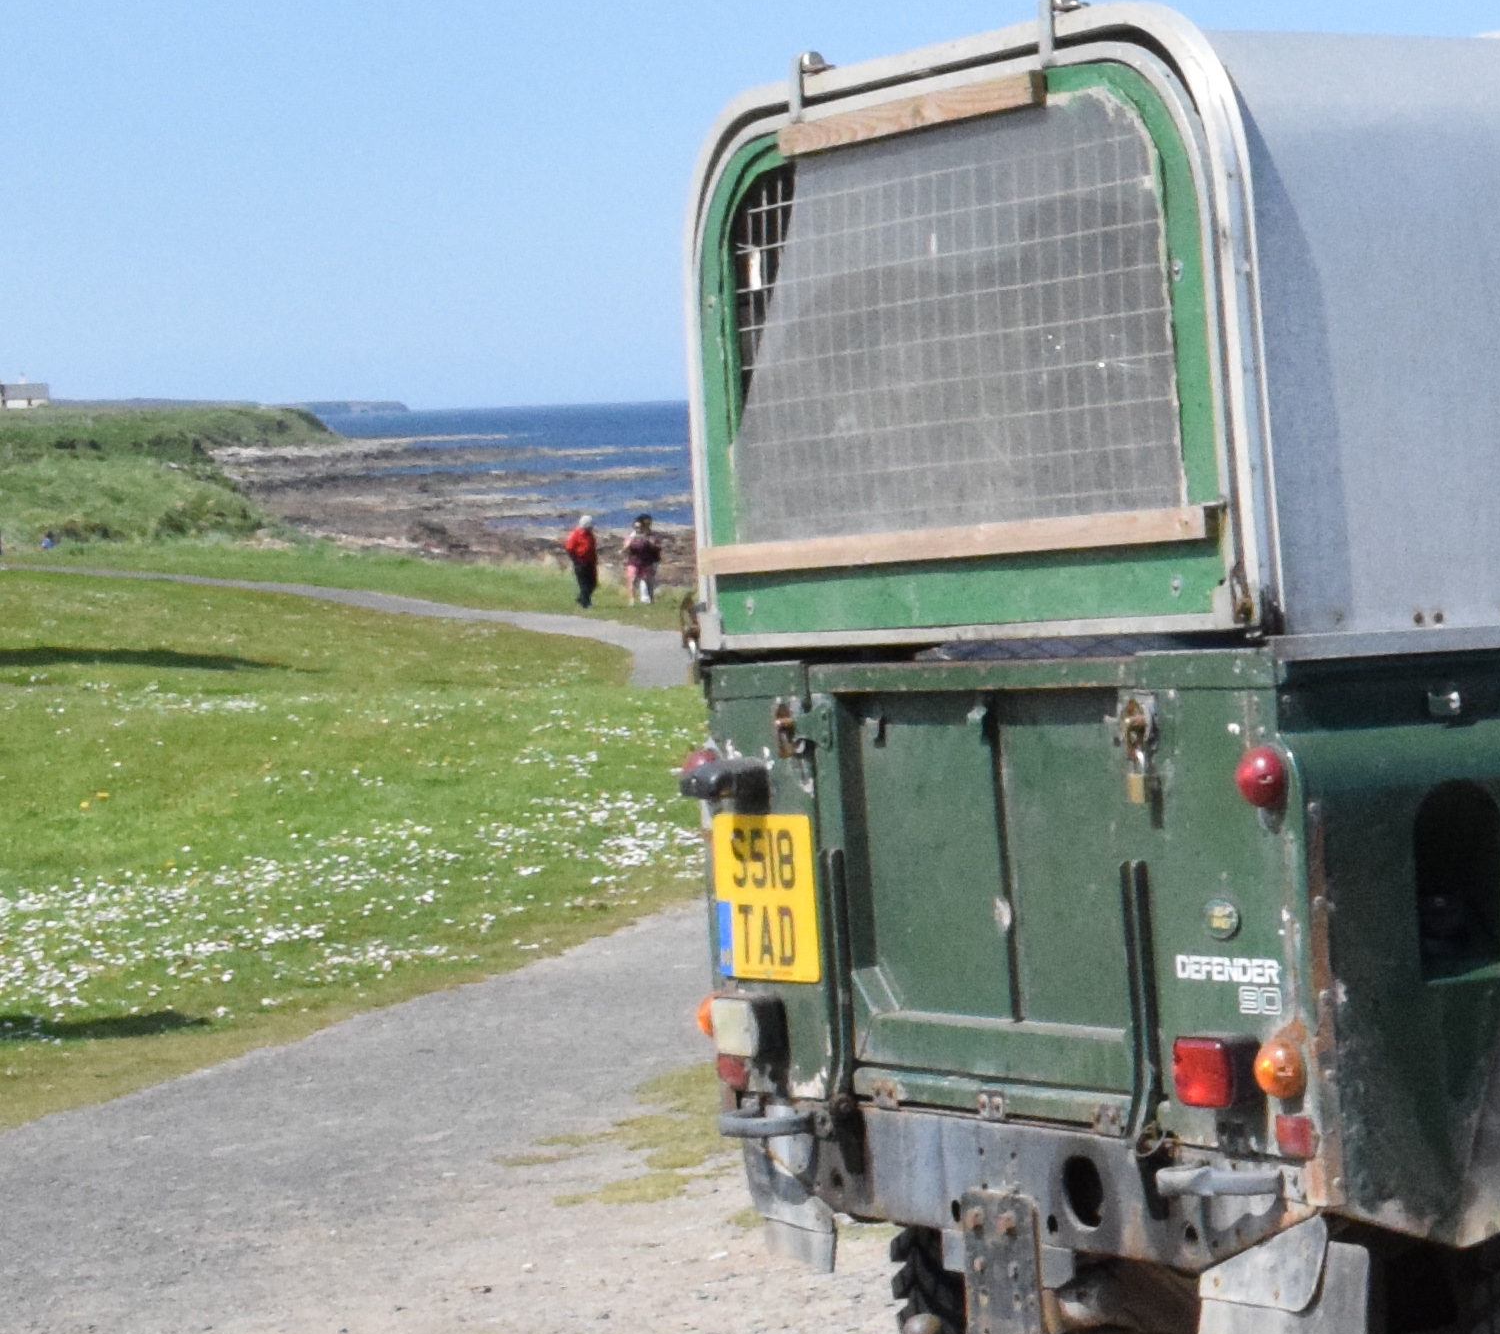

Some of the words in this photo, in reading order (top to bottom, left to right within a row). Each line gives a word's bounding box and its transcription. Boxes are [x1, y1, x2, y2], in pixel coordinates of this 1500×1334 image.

[731, 828, 796, 890] S518
[737, 904, 796, 966] TAD
[1176, 954, 1281, 984] DEFENDER
[1238, 986, 1282, 1015] 90
